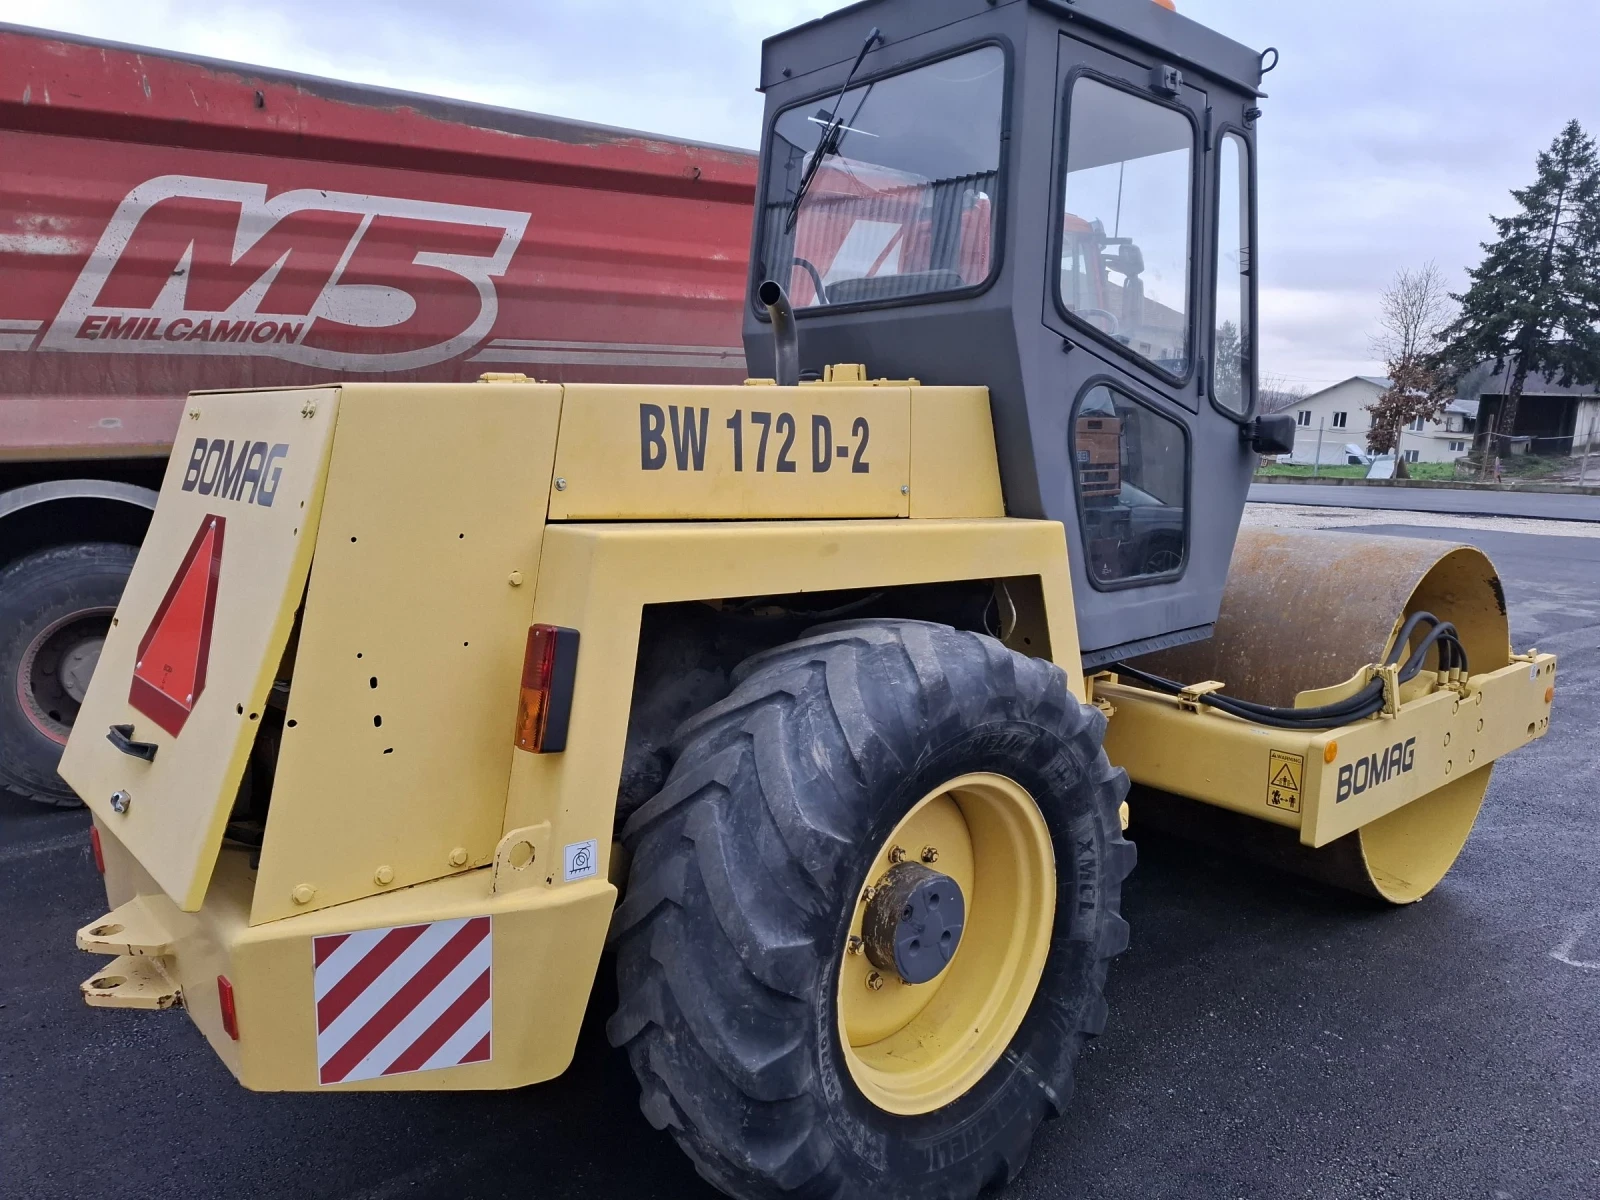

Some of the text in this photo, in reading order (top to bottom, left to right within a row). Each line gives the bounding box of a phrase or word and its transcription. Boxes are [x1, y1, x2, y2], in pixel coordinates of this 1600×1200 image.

[38, 174, 531, 372] M5
[75, 315, 306, 345] EMILCAMION
[181, 437, 290, 508] BOMAG
[639, 403, 870, 474] BW 172 D-2
[1277, 753, 1302, 764] WARNING
[1335, 736, 1417, 804] BOMAG
[1076, 837, 1098, 916] XMCL
